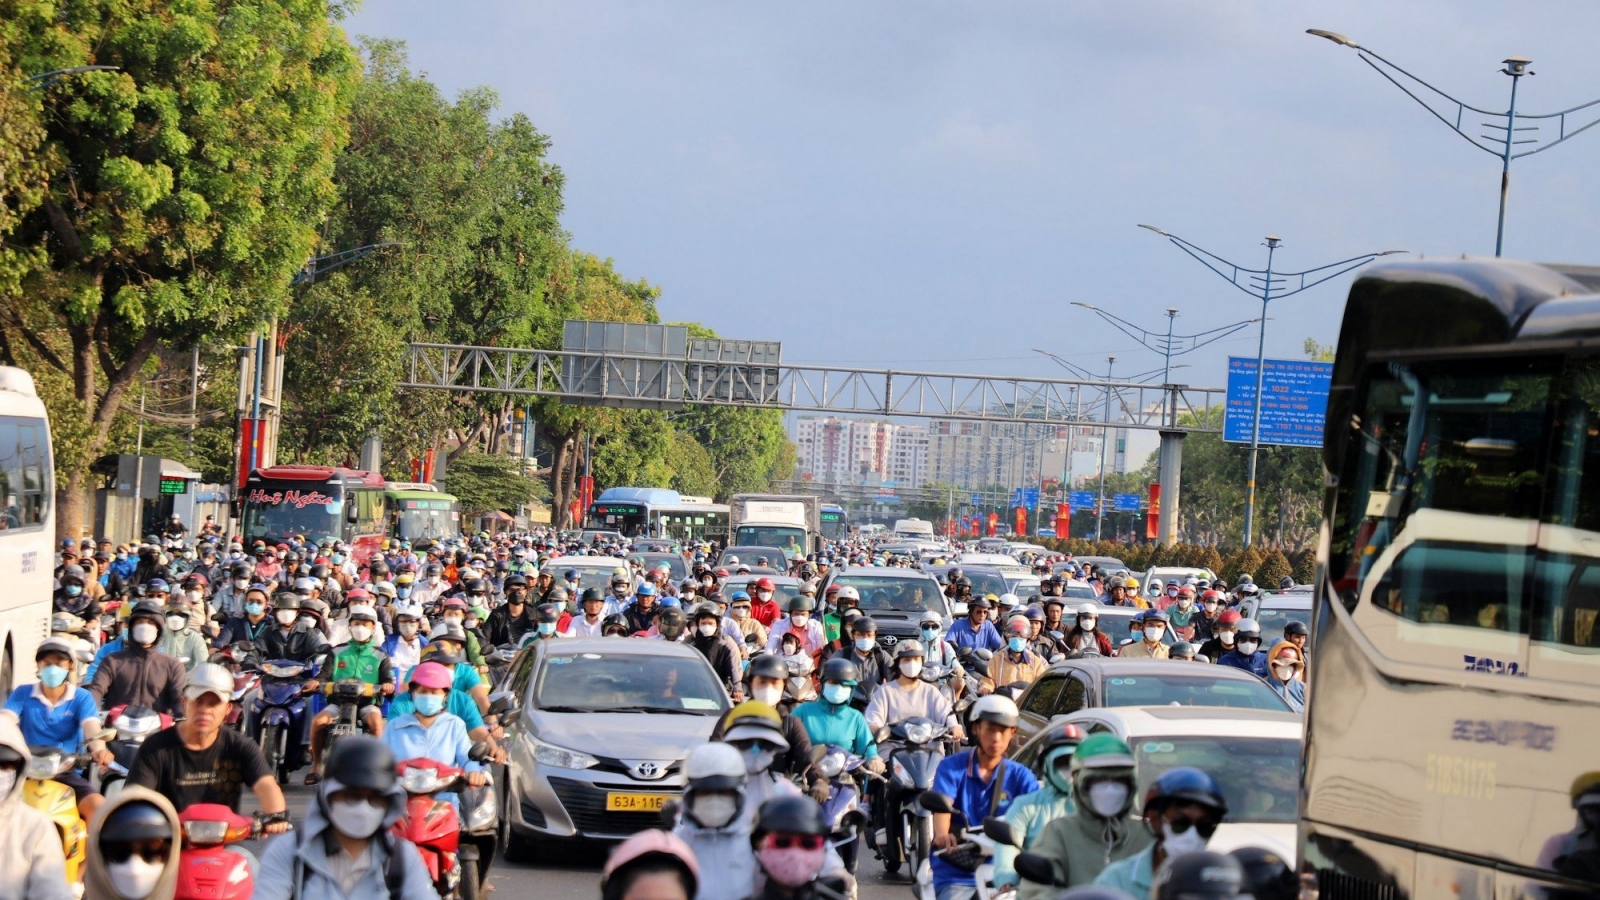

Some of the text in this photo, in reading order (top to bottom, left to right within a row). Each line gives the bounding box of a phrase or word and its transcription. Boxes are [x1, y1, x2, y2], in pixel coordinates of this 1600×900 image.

[250, 488, 334, 508] Huệ Nghĩa
[614, 796, 662, 808] 63A-116
